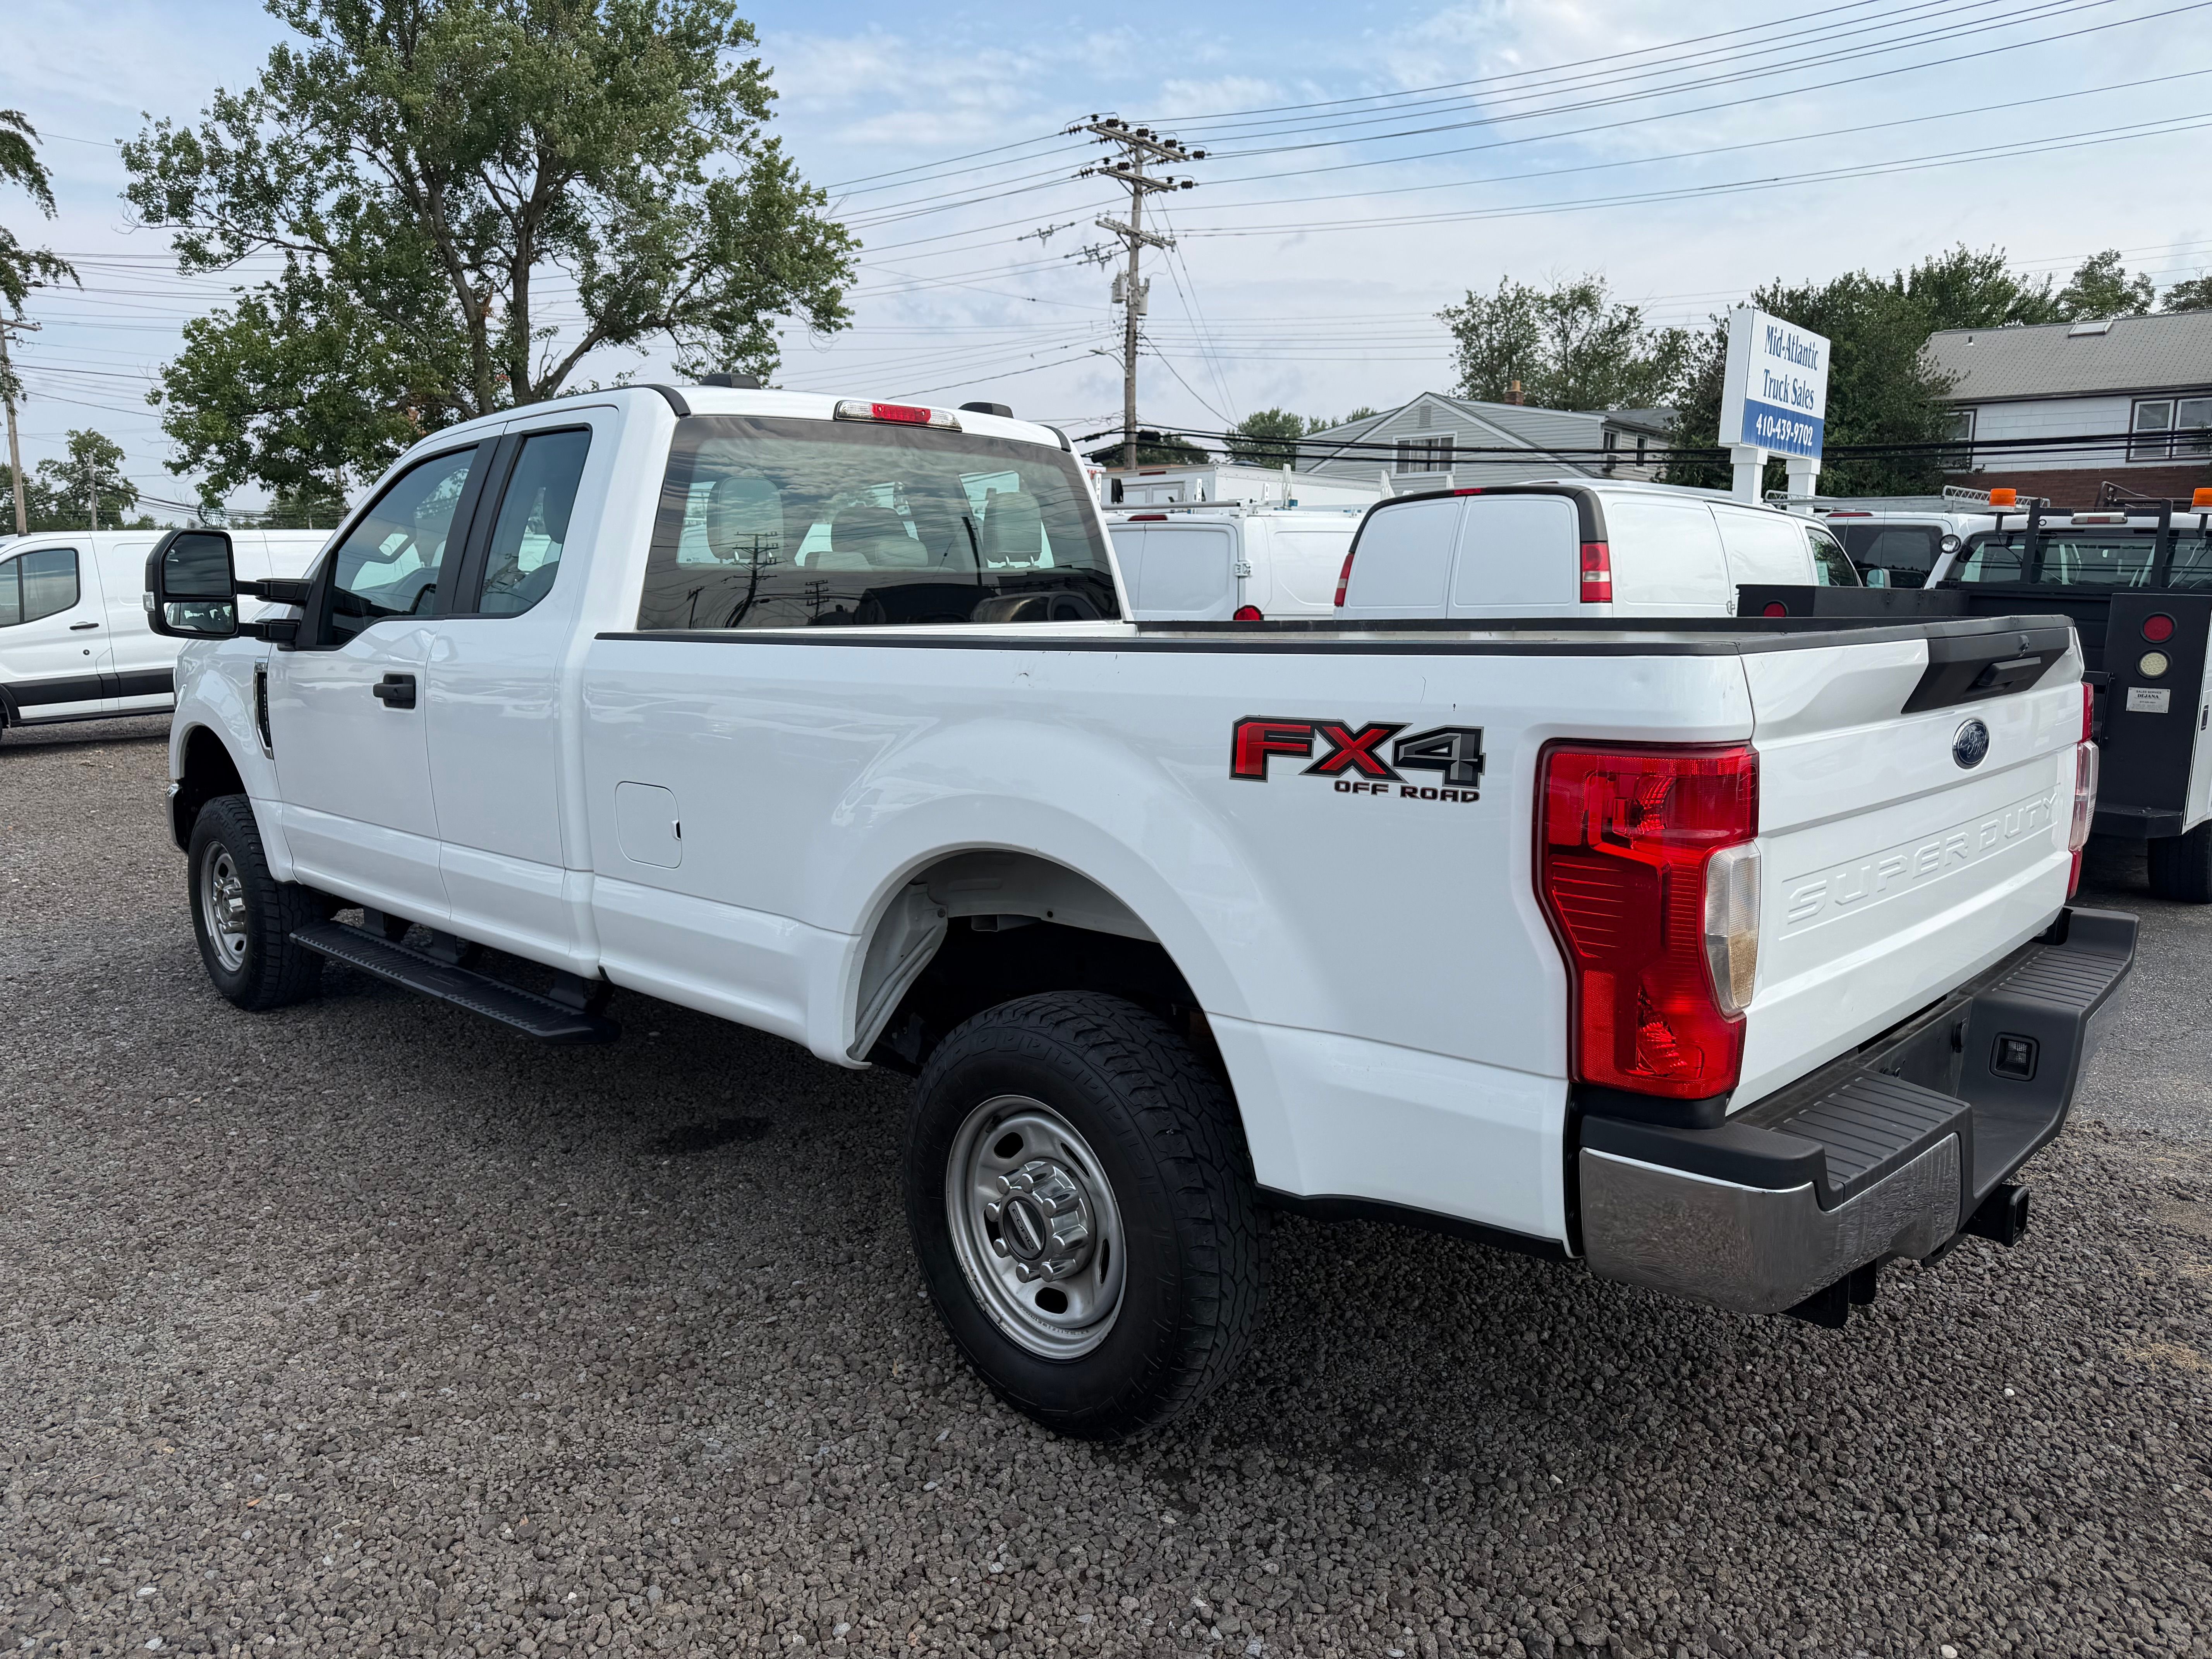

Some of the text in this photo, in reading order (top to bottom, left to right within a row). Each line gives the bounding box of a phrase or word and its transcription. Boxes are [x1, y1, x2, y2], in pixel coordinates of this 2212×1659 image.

[1764, 324, 1819, 371] Mid-Atlantic
[1763, 368, 1814, 410] Truck Sales
[1756, 413, 1813, 447] 410-439-9702
[1229, 714, 1487, 789] FX4
[1959, 728, 1987, 758] Ford
[1334, 780, 1480, 804] OFF ROAD
[1787, 792, 2057, 925] SUPER DUTY
[1012, 1208, 1034, 1250] FORD
